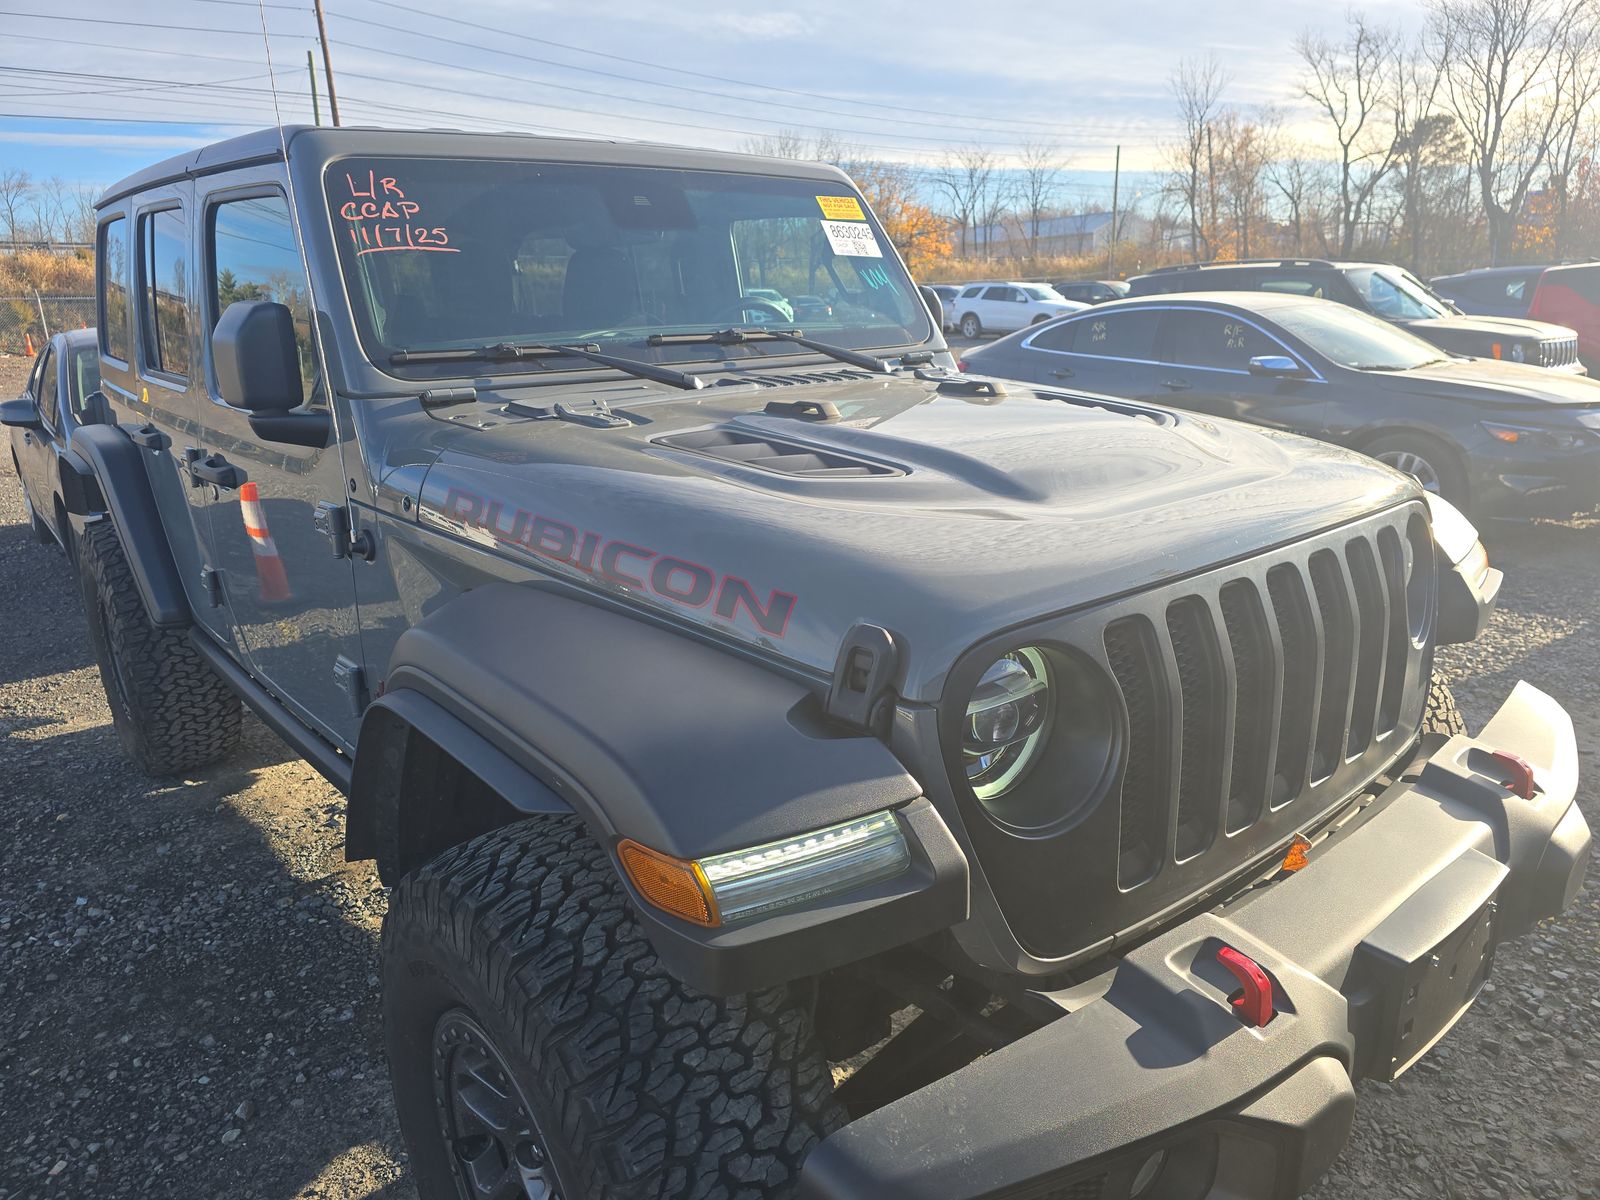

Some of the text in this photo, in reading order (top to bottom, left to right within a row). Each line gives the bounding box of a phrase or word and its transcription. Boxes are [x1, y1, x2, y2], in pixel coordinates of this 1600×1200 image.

[347, 170, 405, 199] L/R
[340, 201, 420, 220] CCAP
[350, 224, 448, 247] 11/7/25
[443, 487, 798, 639] RUBICON
